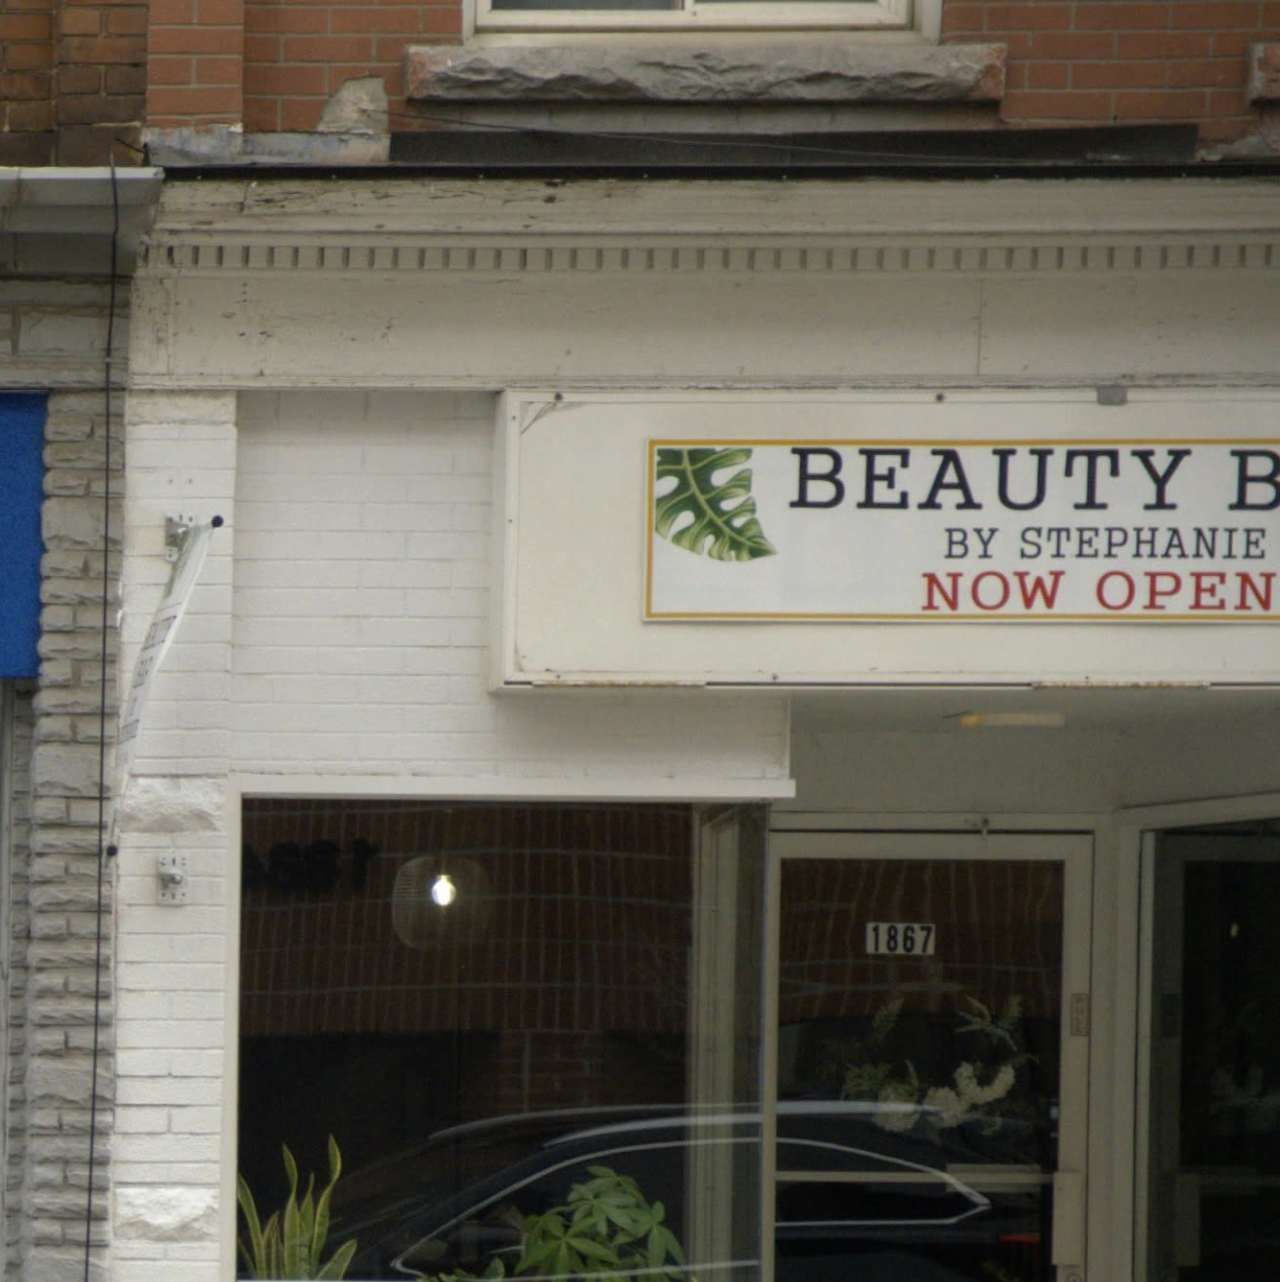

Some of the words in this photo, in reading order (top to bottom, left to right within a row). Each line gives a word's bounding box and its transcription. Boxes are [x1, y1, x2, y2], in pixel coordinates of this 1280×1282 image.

[788, 446, 1194, 512] BEAUTY
[1226, 448, 1280, 512] B
[944, 527, 999, 560] BY
[1019, 527, 1267, 560] STEPHANIE
[921, 570, 1066, 611] NOW
[1096, 570, 1277, 612] OPEN
[870, 924, 935, 955] 1867
